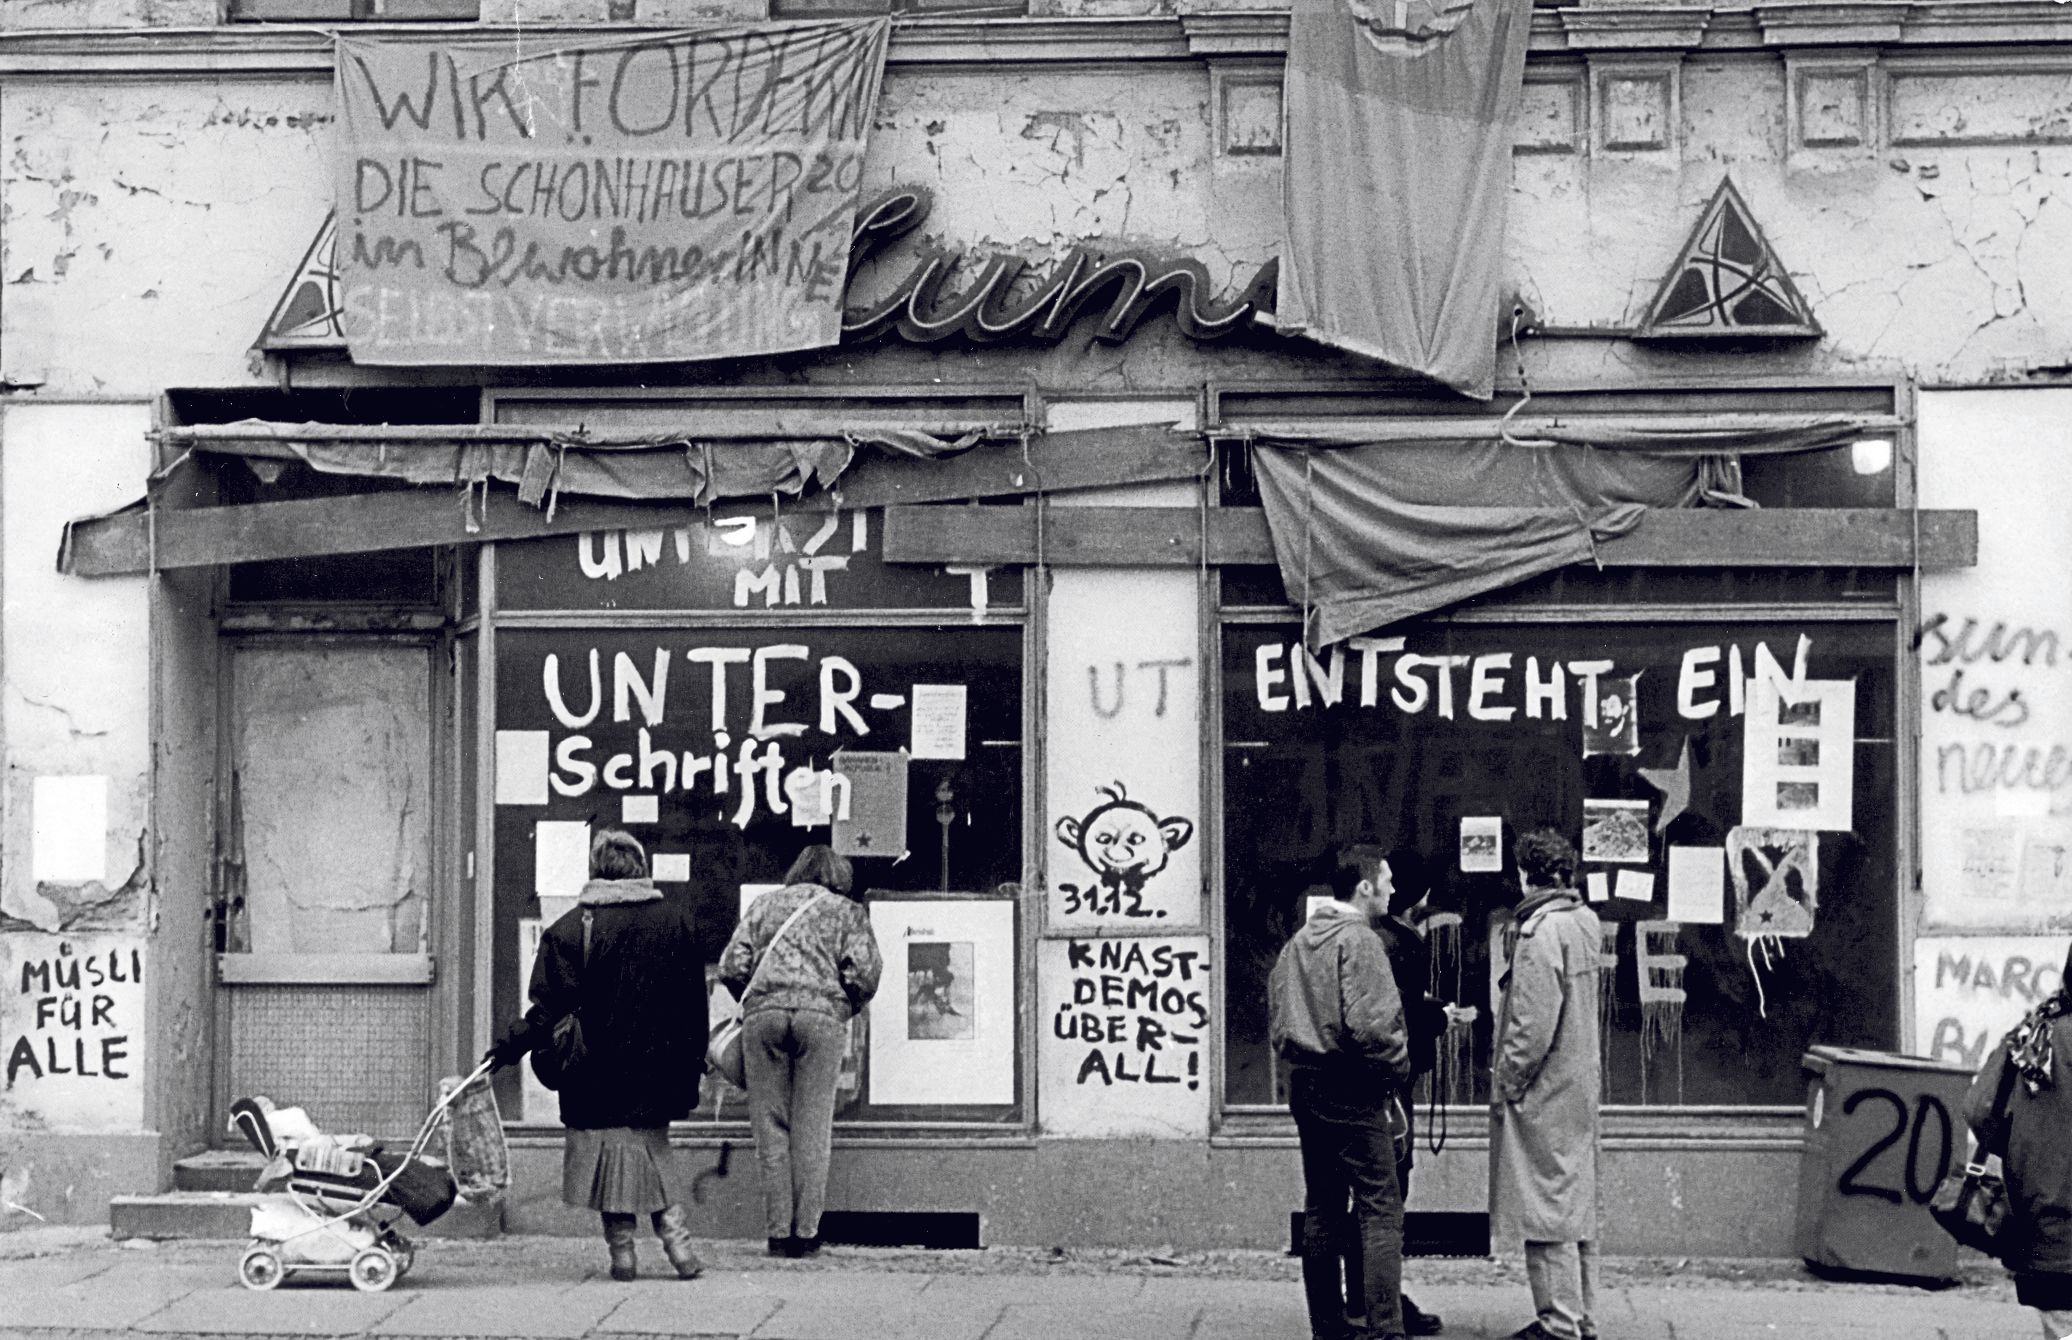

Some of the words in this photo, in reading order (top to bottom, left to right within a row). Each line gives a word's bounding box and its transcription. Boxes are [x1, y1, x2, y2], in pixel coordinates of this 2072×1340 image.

[355, 48, 534, 142] WIR
[571, 27, 877, 142] FORDERN
[355, 157, 443, 218] DIE
[806, 153, 866, 193] 20
[733, 555, 850, 608] MIT
[542, 643, 906, 742] UNTER-
[1254, 636, 1615, 721] ENTSTEHT
[1676, 633, 1814, 720] EIN
[1931, 668, 2030, 728] des
[548, 726, 852, 831] Schriften
[20, 942, 143, 994] MÜSLI
[1068, 940, 1212, 981] KNAST-
[35, 993, 118, 1030] FÜR
[1053, 1002, 1199, 1052] ÜBER-
[1073, 974, 1210, 1031] DEMOS
[6, 1034, 130, 1090] ALLE
[1076, 1047, 1199, 1091] ALL!
[1838, 1087, 1953, 1206] 20
